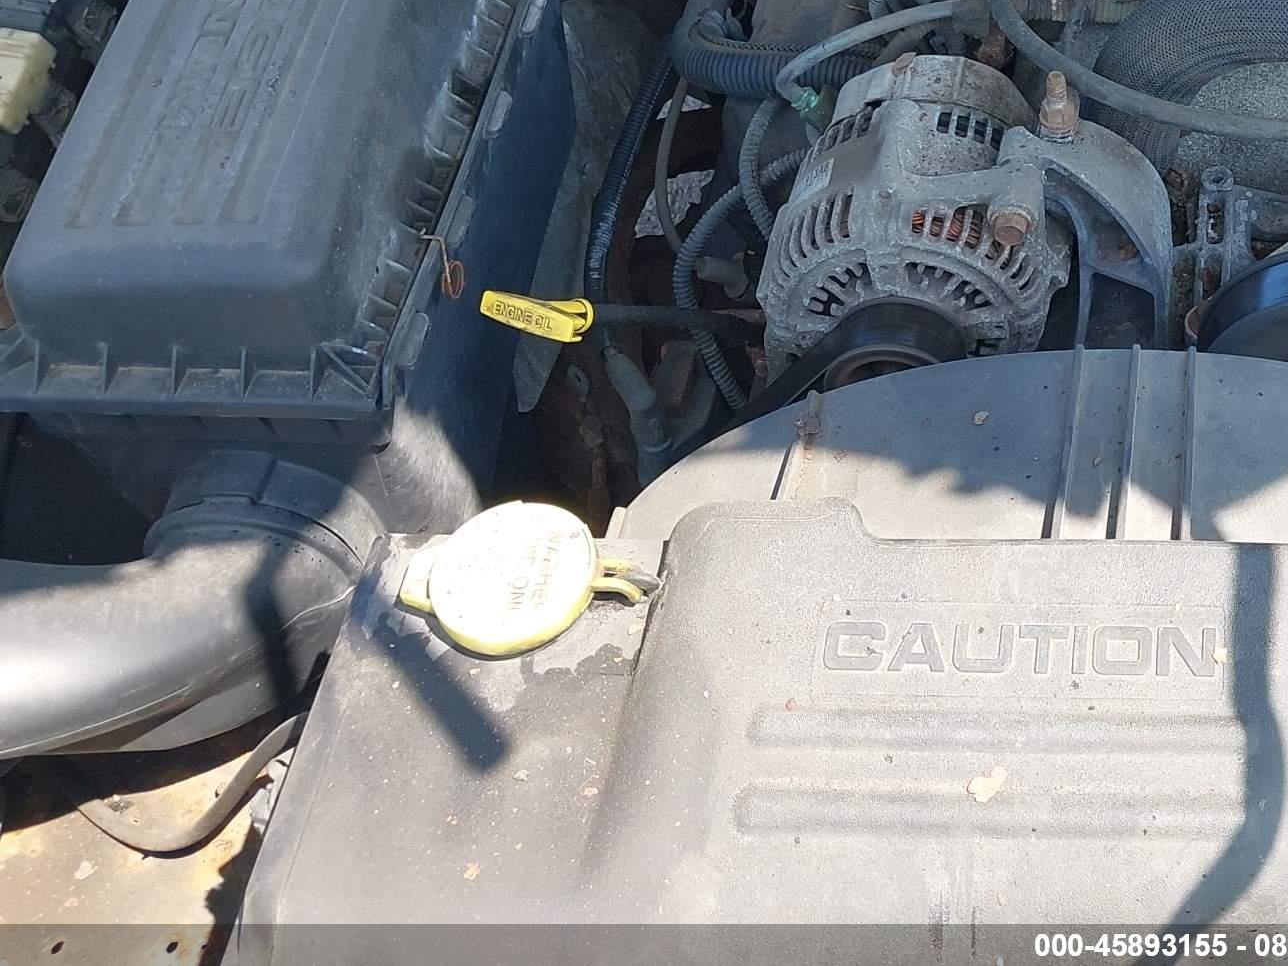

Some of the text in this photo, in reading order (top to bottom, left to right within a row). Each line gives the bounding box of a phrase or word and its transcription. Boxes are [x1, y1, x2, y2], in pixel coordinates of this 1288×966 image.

[494, 301, 553, 331] ENGINE OIL
[824, 621, 1217, 677] CAUTION
